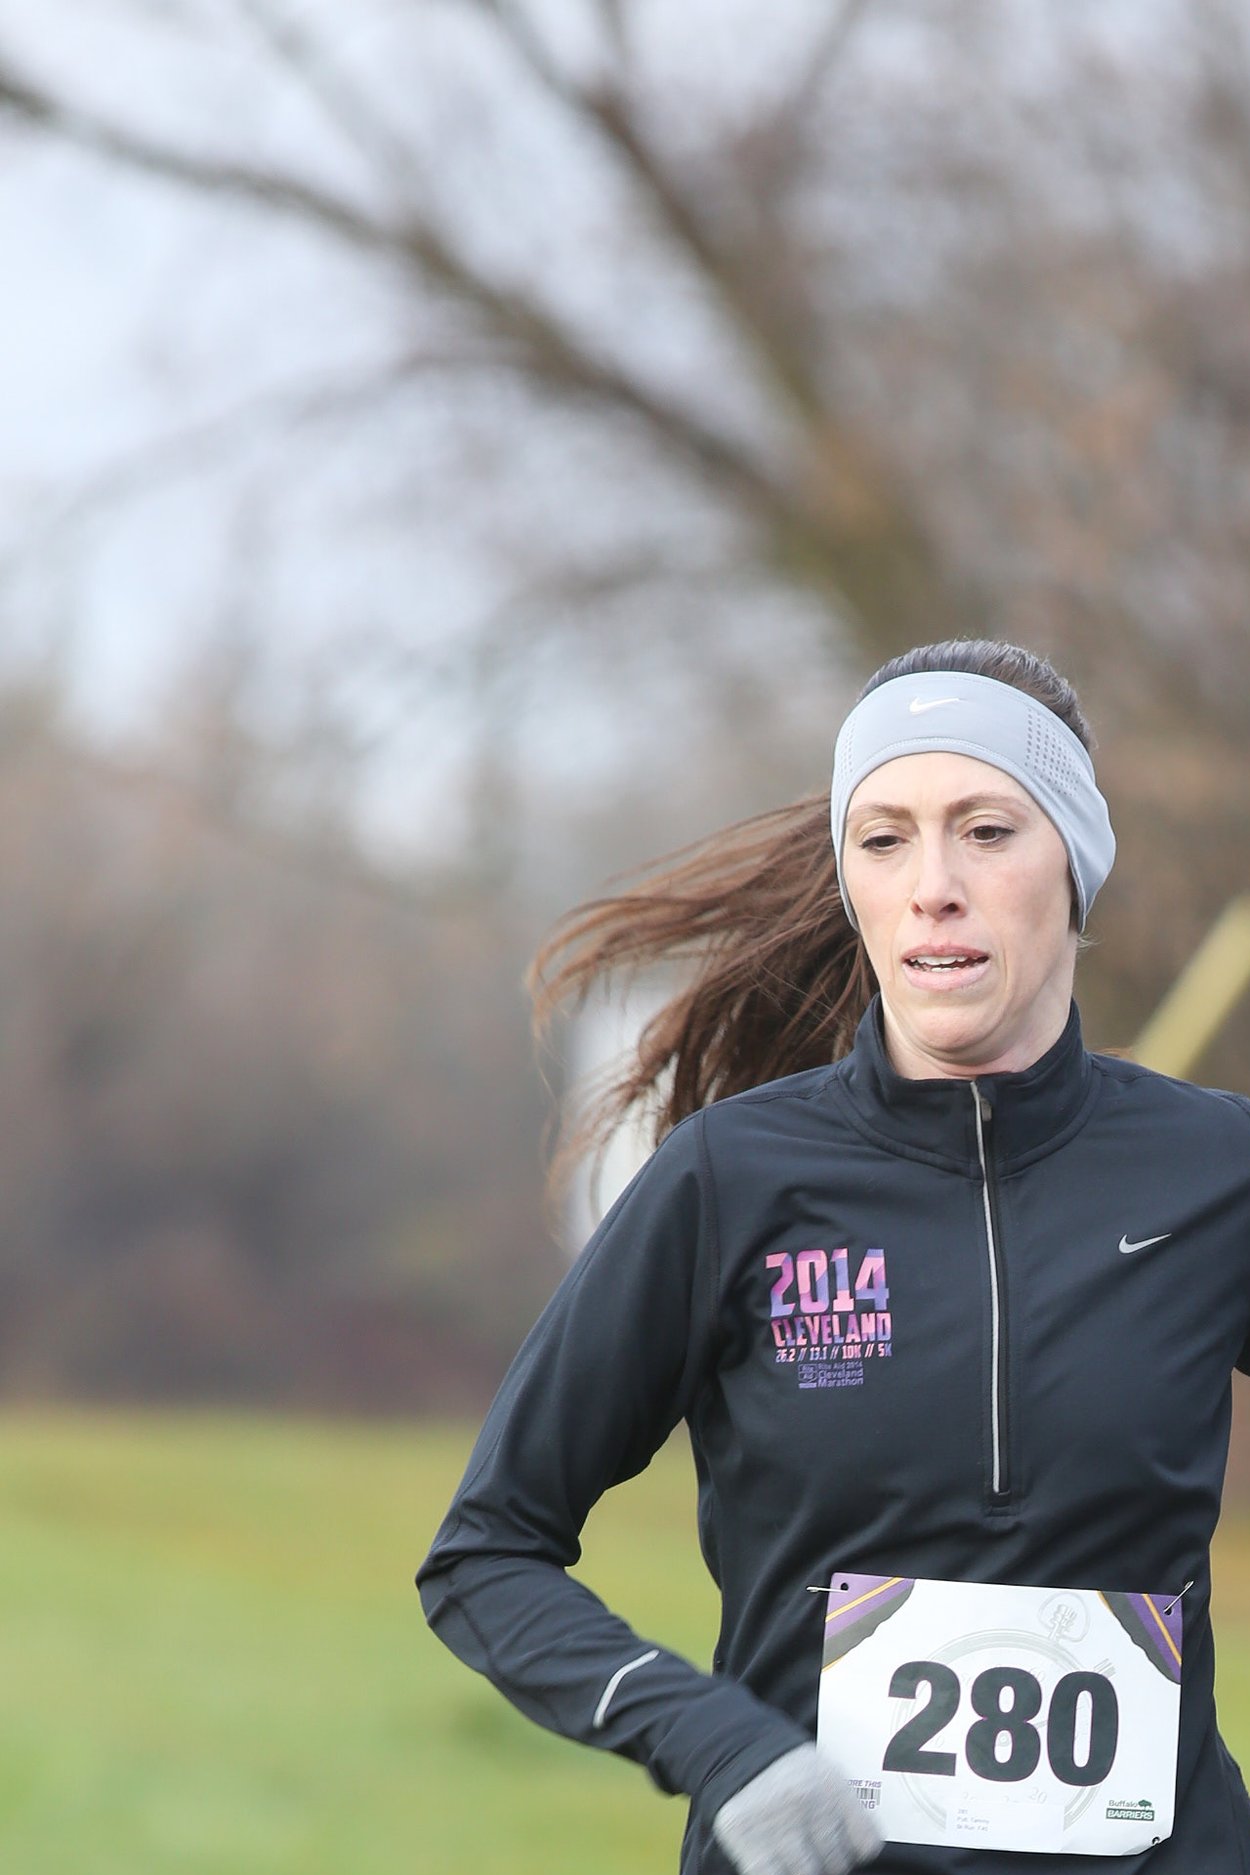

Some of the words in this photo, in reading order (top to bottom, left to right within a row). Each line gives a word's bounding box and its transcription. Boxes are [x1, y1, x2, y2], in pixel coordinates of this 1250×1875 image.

[765, 1247, 890, 1318] 2014
[771, 1312, 892, 1348] CLEVELAND
[775, 1348, 796, 1363] 26.2
[809, 1345, 828, 1361] 13.1
[842, 1344, 862, 1360] 10K
[877, 1342, 893, 1358] 5K
[818, 1367, 864, 1380] Cleveland
[818, 1377, 864, 1388] Marathon
[882, 1660, 1119, 1787] 280
[1108, 1799, 1138, 1808] Buffalo
[1107, 1809, 1153, 1820] BARRIERS
